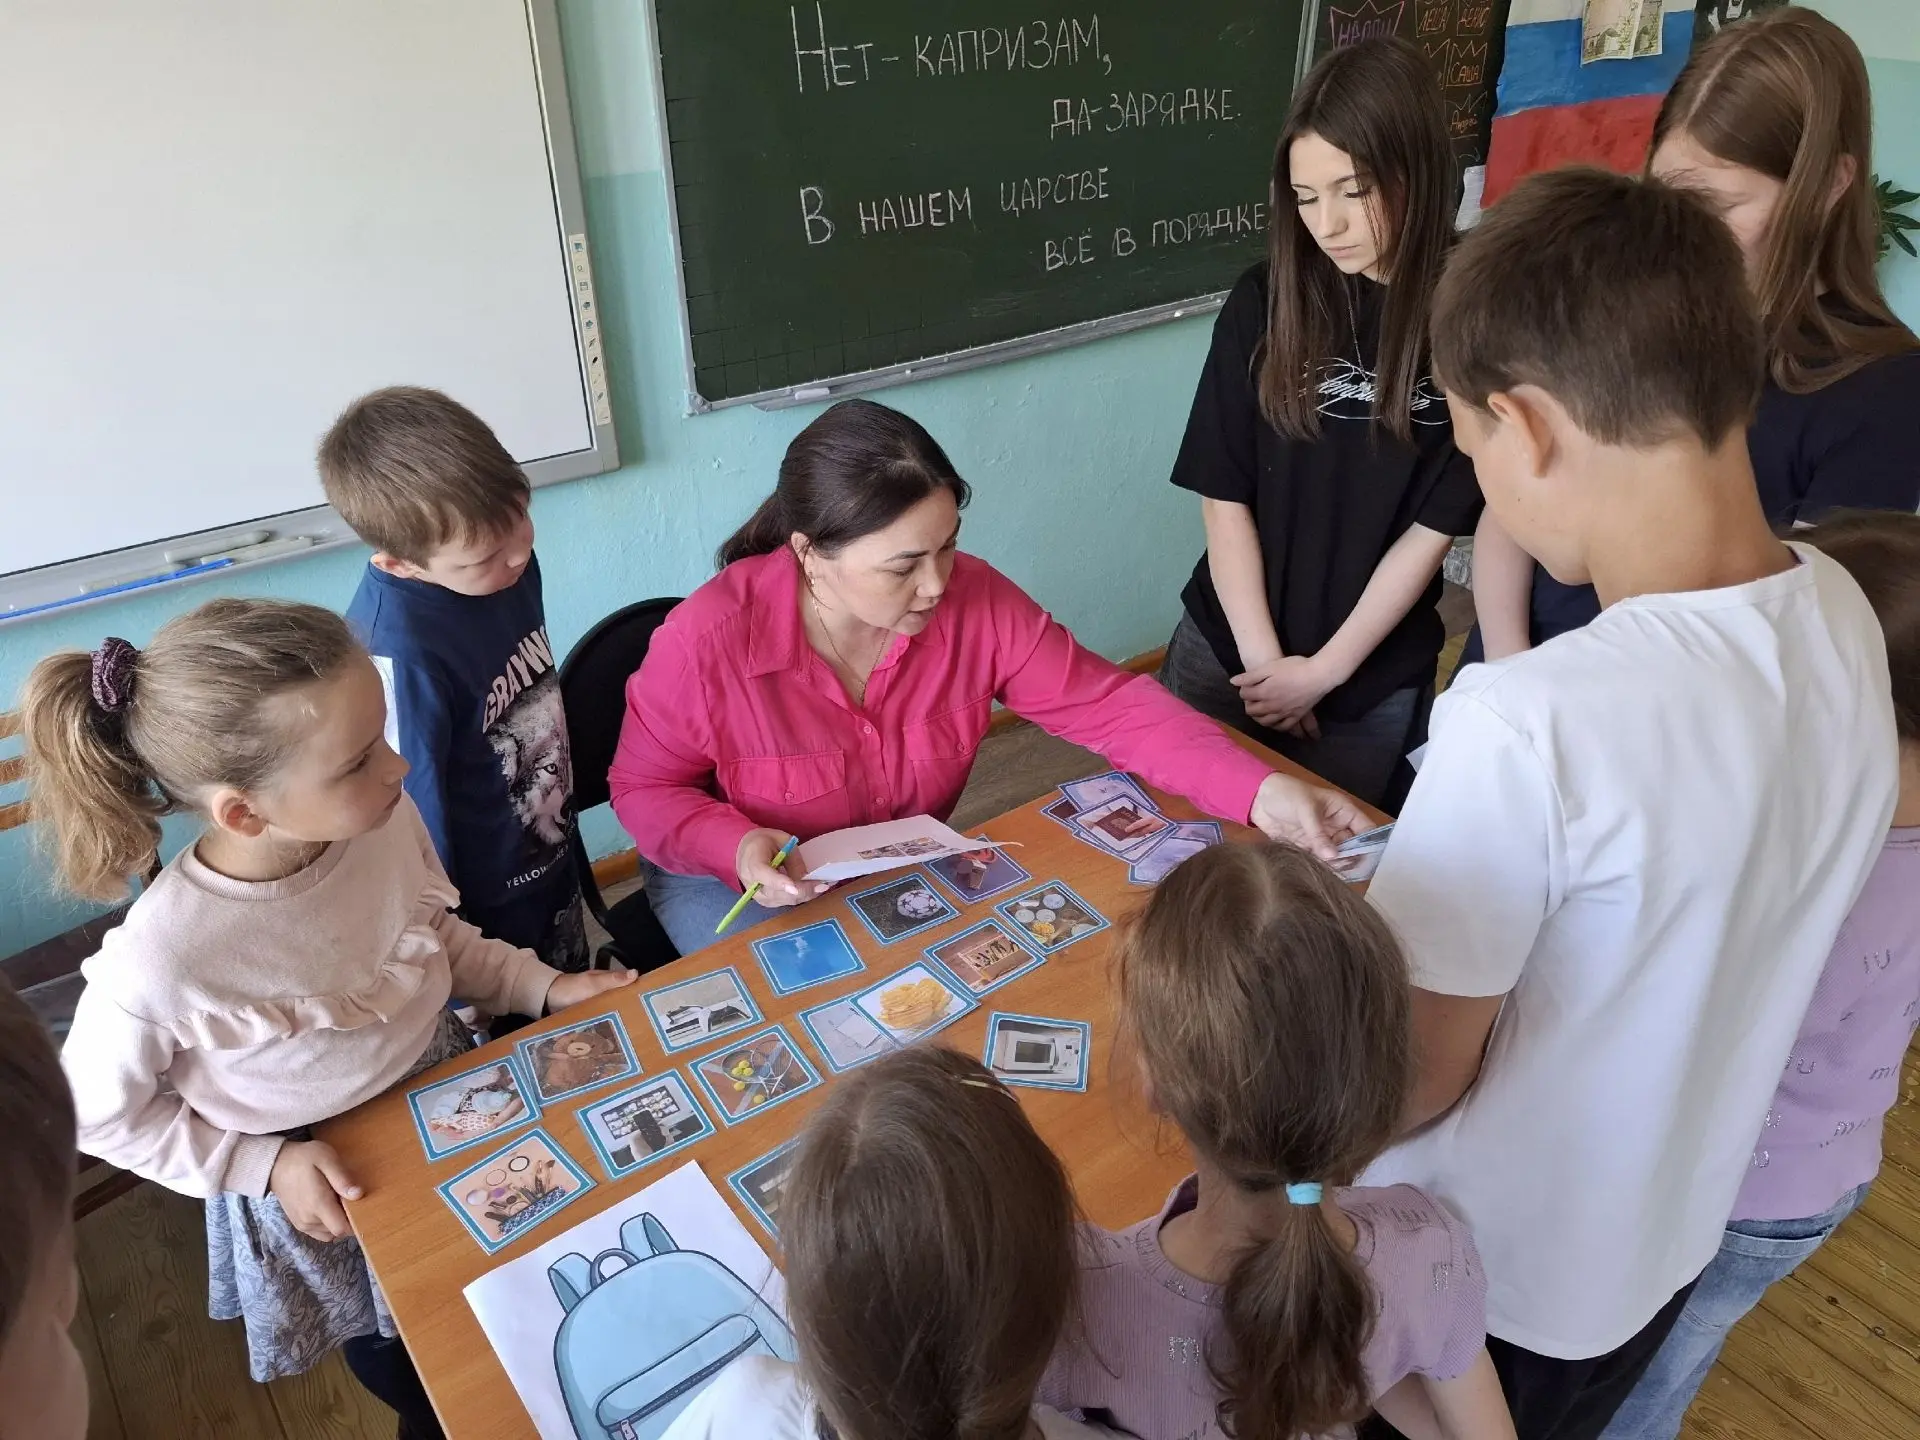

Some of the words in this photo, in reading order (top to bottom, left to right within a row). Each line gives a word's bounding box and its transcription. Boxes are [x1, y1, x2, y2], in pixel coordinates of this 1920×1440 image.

[914, 14, 1112, 77] КАПРИЗАМ,
[1450, 61, 1480, 83] САША
[800, 187, 835, 245] В
[858, 188, 972, 234] НАШЕМ
[1001, 167, 1110, 217] ЦАРСТВЕ
[1112, 227, 1137, 257] В
